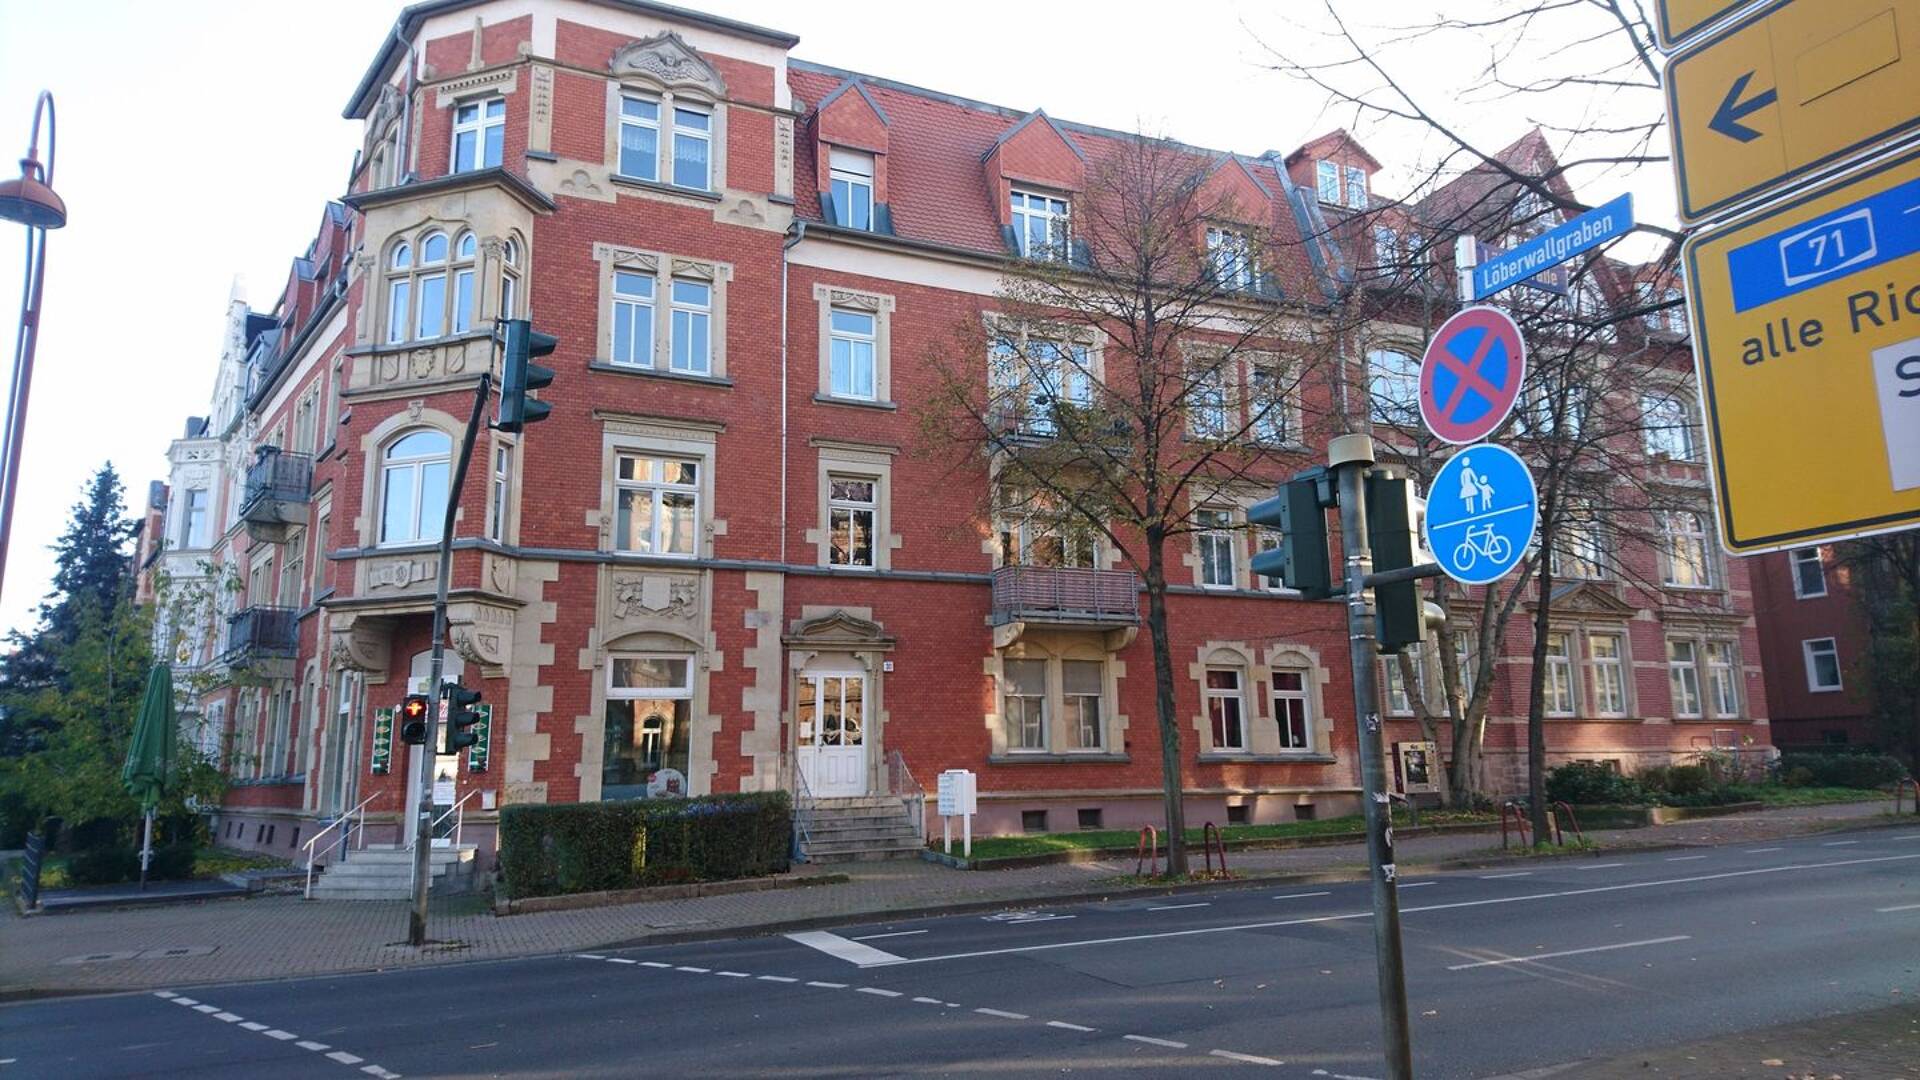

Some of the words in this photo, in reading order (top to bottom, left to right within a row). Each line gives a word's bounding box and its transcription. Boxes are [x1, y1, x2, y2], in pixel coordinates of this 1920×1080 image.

[1484, 215, 1613, 290] Löberwallgraben
[1808, 228, 1845, 267] 71
[1741, 317, 1824, 366] alle
